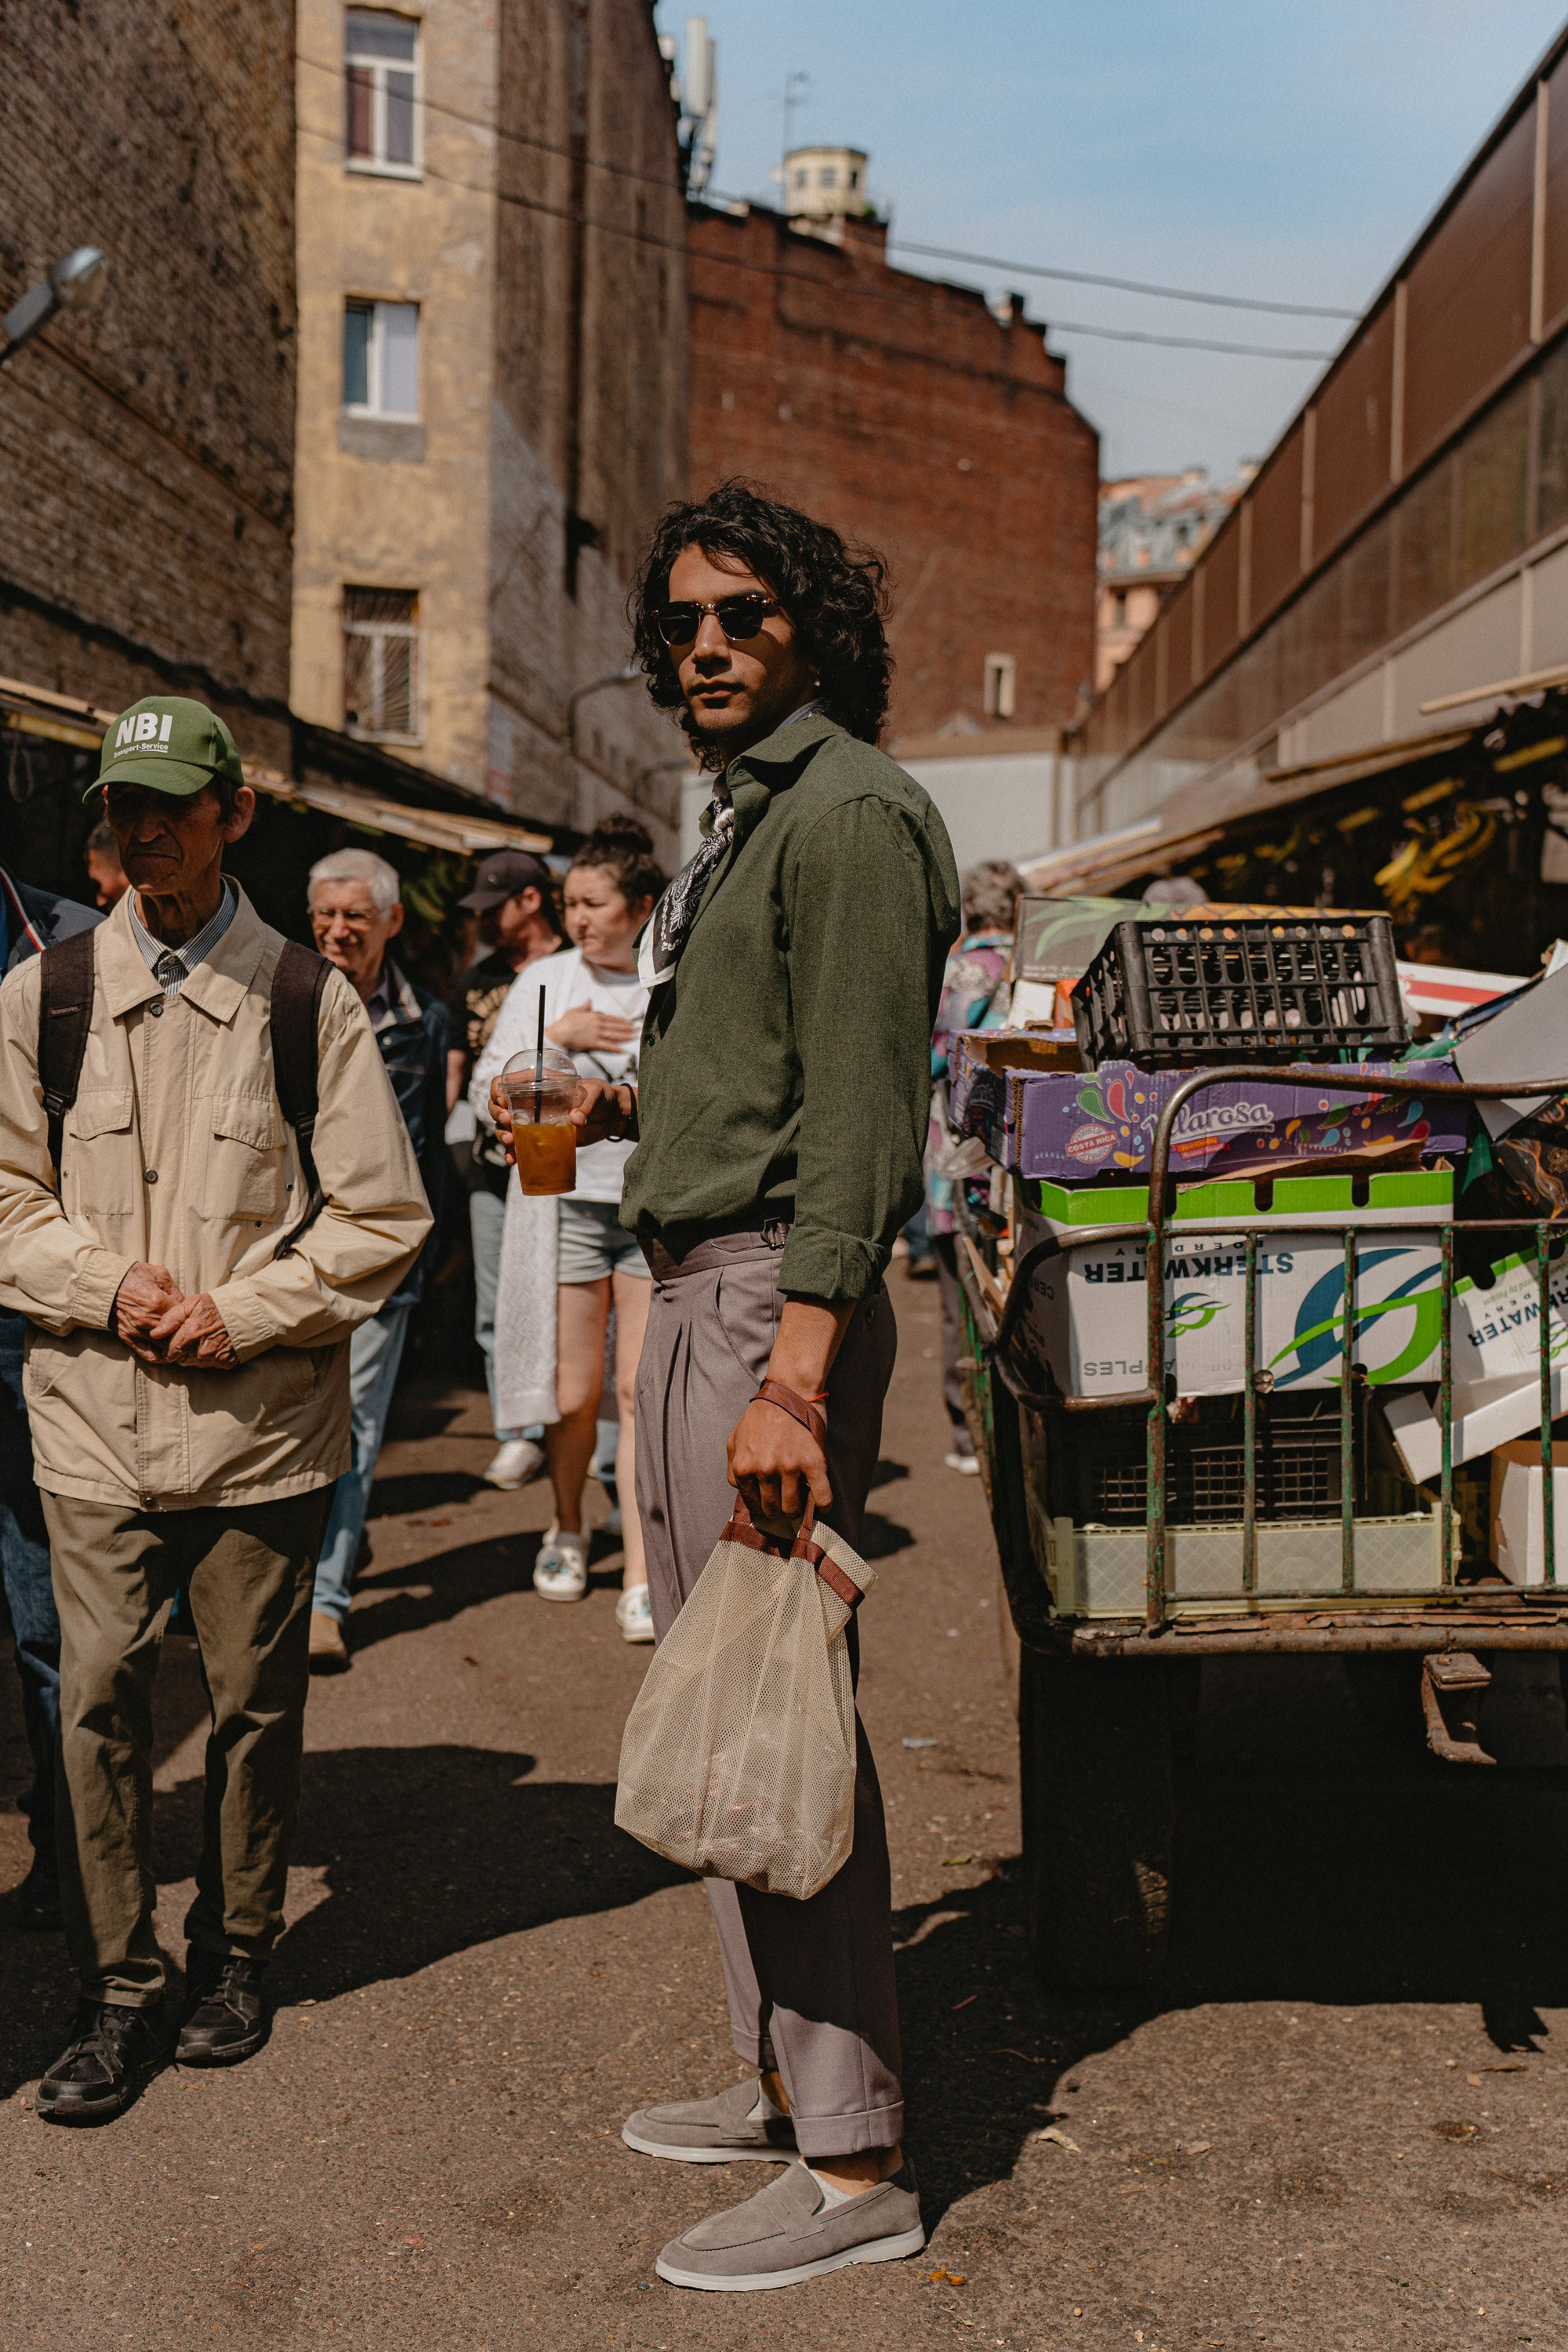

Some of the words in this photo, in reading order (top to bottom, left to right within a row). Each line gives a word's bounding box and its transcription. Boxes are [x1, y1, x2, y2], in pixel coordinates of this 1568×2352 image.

[115, 713, 173, 748] NBI
[114, 742, 169, 758] Transport-Service
[1067, 1141, 1095, 1152] COSTA
[1096, 1134, 1116, 1145] RICA
[1116, 1240, 1263, 1255] BOERDRY
[1084, 1253, 1294, 1283] STERKWTER
[1083, 1358, 1176, 1376] APLES
